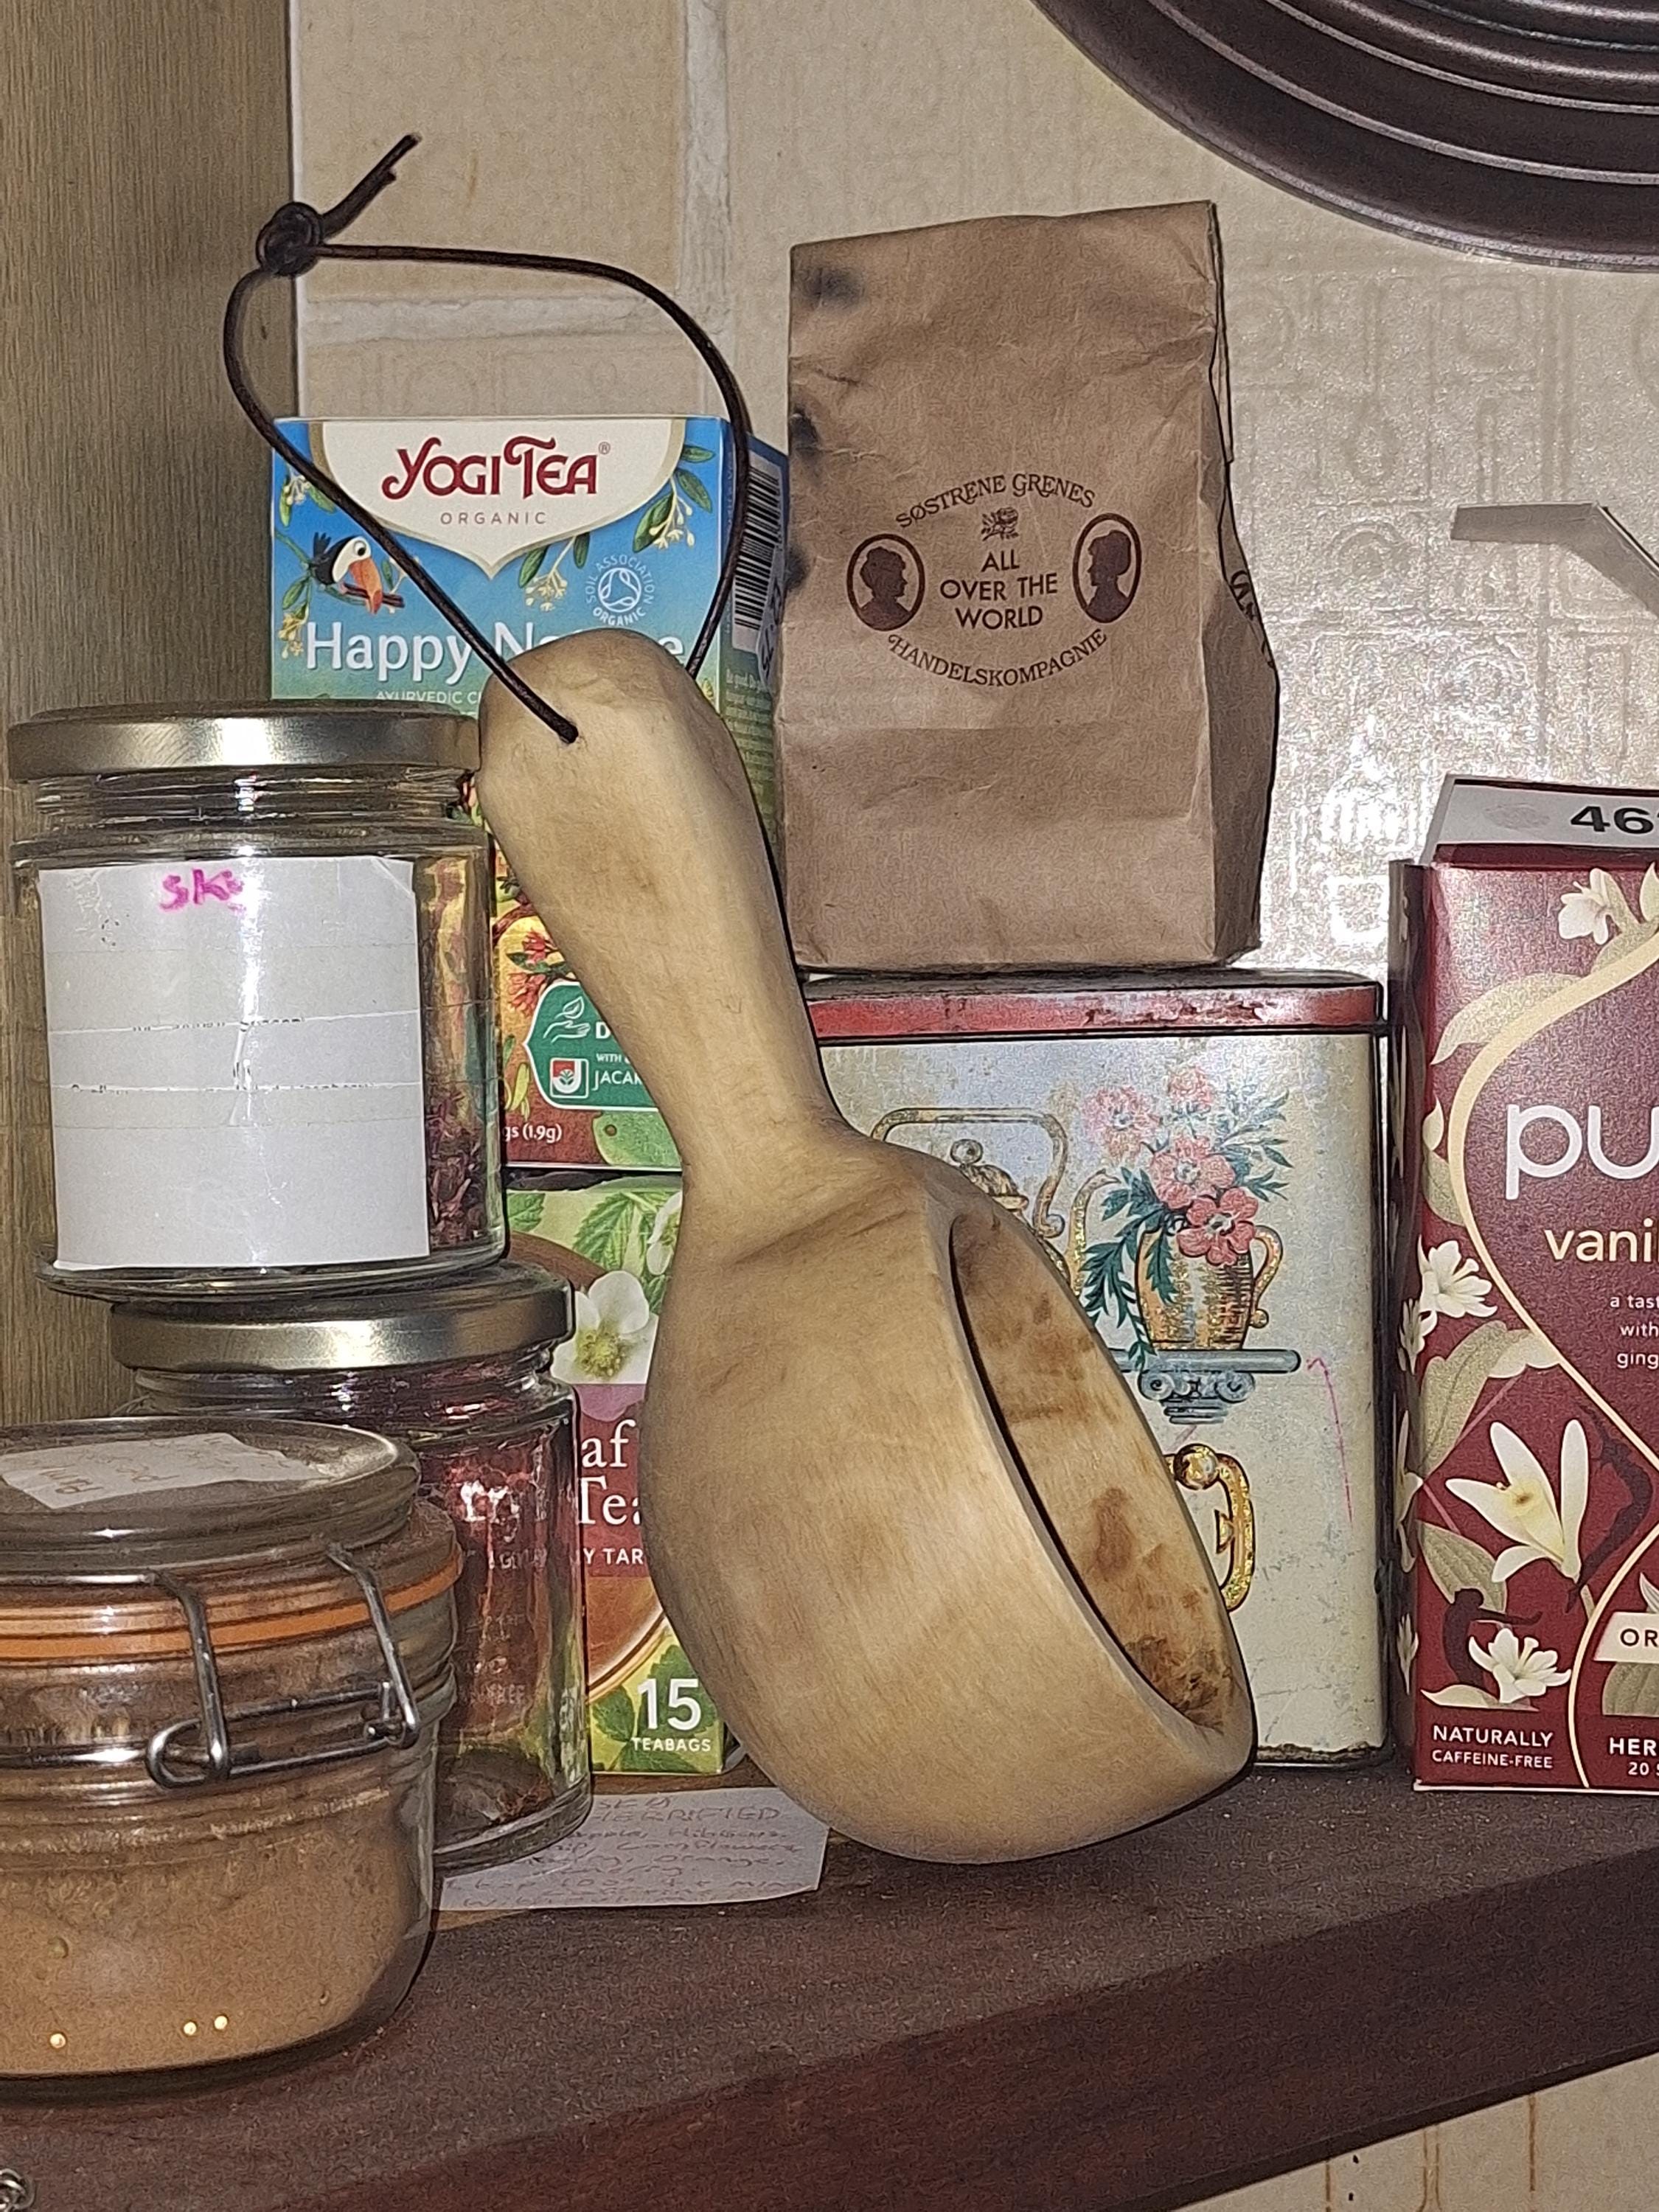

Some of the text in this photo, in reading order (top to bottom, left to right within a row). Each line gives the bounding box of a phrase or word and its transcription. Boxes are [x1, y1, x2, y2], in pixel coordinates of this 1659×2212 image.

[381, 437, 501, 499] YOGI
[504, 435, 597, 499] TEA
[896, 473, 1096, 528] SØSTRENE GRENES
[440, 512, 546, 525] ORGANIC
[981, 549, 1020, 572] ALL
[585, 554, 655, 605] SOIL ASSOCIATION
[940, 572, 1058, 601] OVER THE
[593, 606, 647, 626] ORGANIC
[955, 605, 1043, 630] WORLD
[307, 622, 473, 686] Happy
[888, 628, 1107, 687] HANDELSKOMPAGNIE
[375, 690, 463, 704] AYURVEDIC
[1571, 806, 1659, 834] 46
[596, 1053, 622, 1062] WITH
[522, 1122, 563, 1144] (1.9g)
[1506, 1104, 1659, 1200] pu
[1544, 1217, 1659, 1262] vani
[1610, 1296, 1620, 1307] a
[1620, 1321, 1659, 1337] with
[637, 1677, 702, 1731] 15
[631, 1736, 712, 1752] TEABAGS
[1433, 1725, 1554, 1748] NATURALLY
[1609, 1737, 1658, 1756] HER
[1432, 1749, 1553, 1769] CAFFEINE-FREE
[1628, 1762, 1649, 1776] 20
